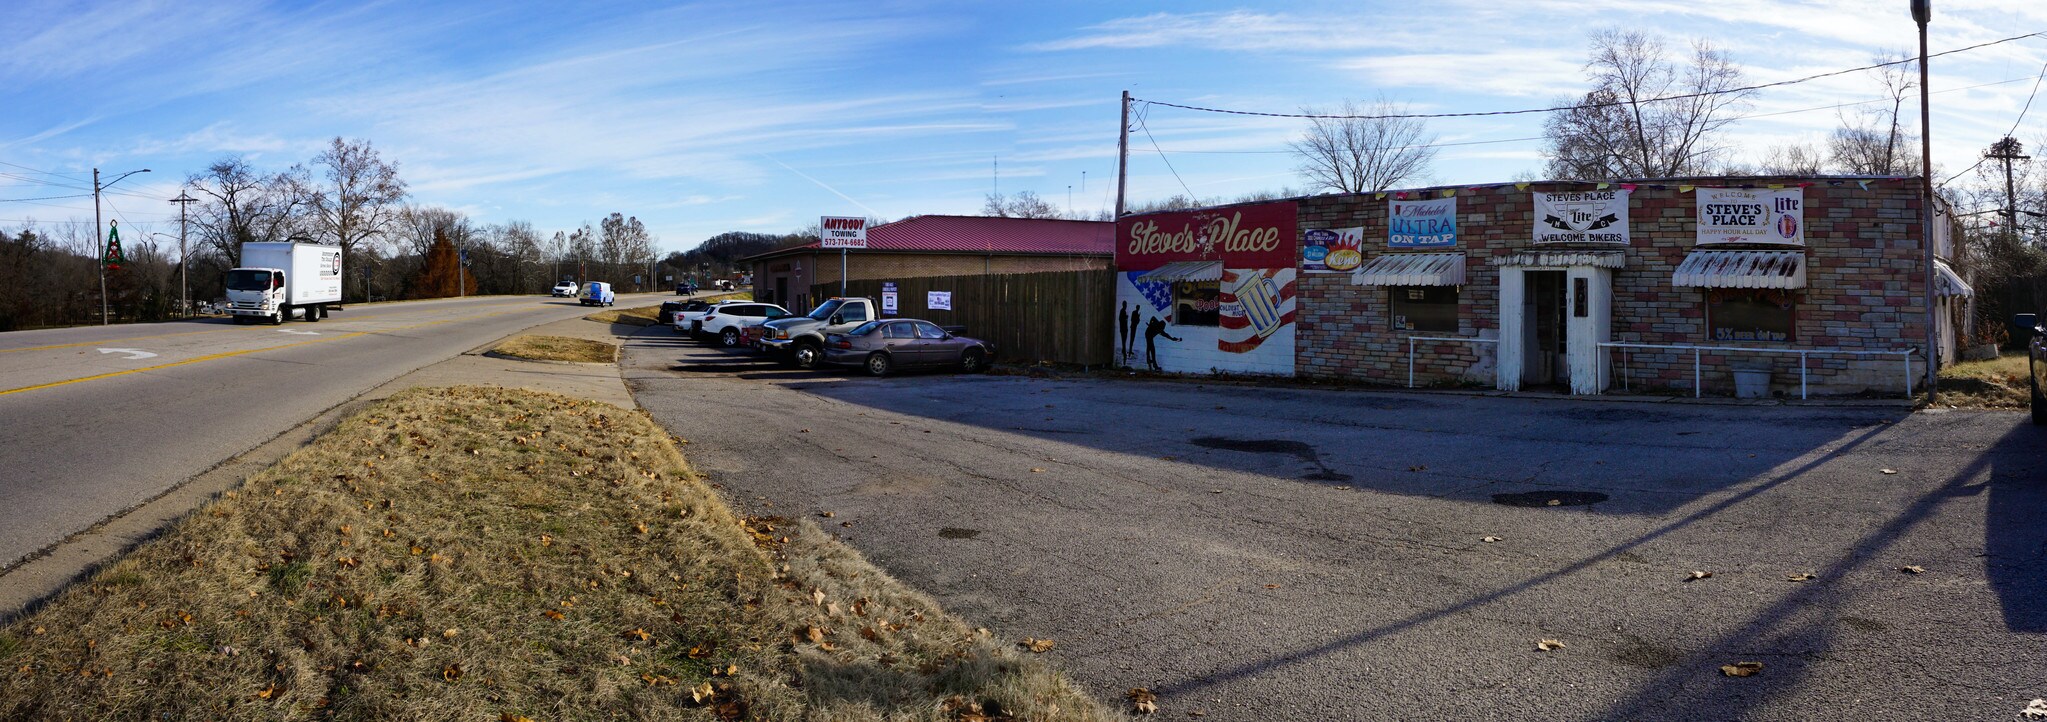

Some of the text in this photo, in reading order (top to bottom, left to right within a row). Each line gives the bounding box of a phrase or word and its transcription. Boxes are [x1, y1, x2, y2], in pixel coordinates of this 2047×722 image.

[1546, 192, 1616, 202] STEVES PLACE
[1711, 191, 1756, 200] WELCOME
[1402, 204, 1449, 217] Michelob
[1706, 203, 1762, 215] STEVE'S
[1774, 197, 1799, 214] Lite
[1572, 211, 1592, 224] Lite
[1712, 215, 1756, 226] PLACE
[824, 218, 865, 230] ANYBODY
[1392, 217, 1453, 234] ULTRA
[831, 230, 857, 238] TOWING
[1128, 210, 1280, 255] Steve's Place
[1541, 233, 1622, 242] WELCOME BIKERS
[1701, 228, 1768, 236] HAPPY HOUR ALL DAY
[1390, 233, 1455, 244] ON TAP
[1328, 252, 1359, 267] Keno
